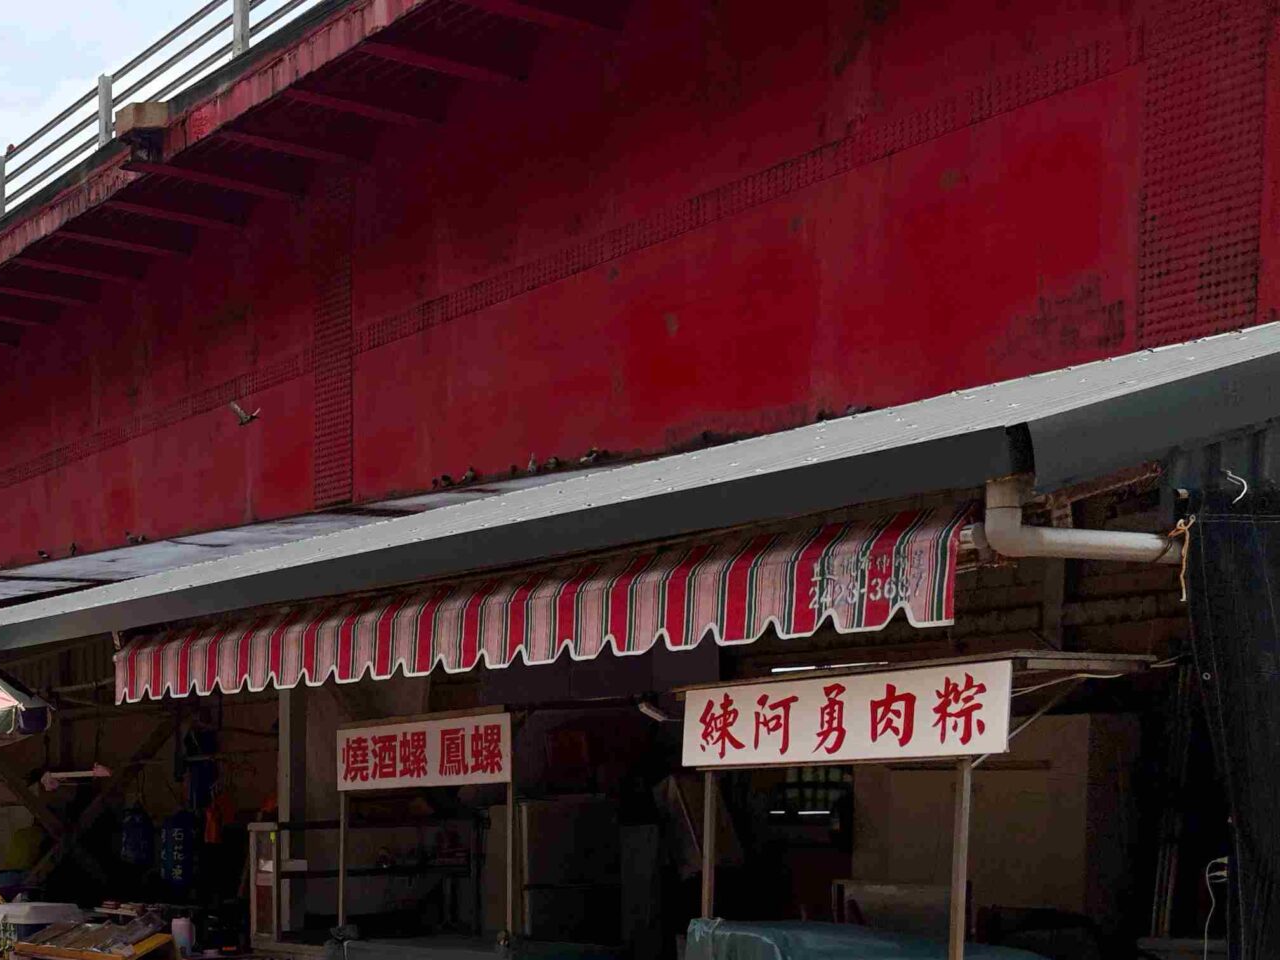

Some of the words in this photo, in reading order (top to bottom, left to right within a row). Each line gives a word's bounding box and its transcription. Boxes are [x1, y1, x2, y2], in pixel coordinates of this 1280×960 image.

[696, 672, 987, 759] 練阿勇肉粽
[342, 731, 428, 782] 燒酒螺
[438, 724, 503, 777] 鳳螺
